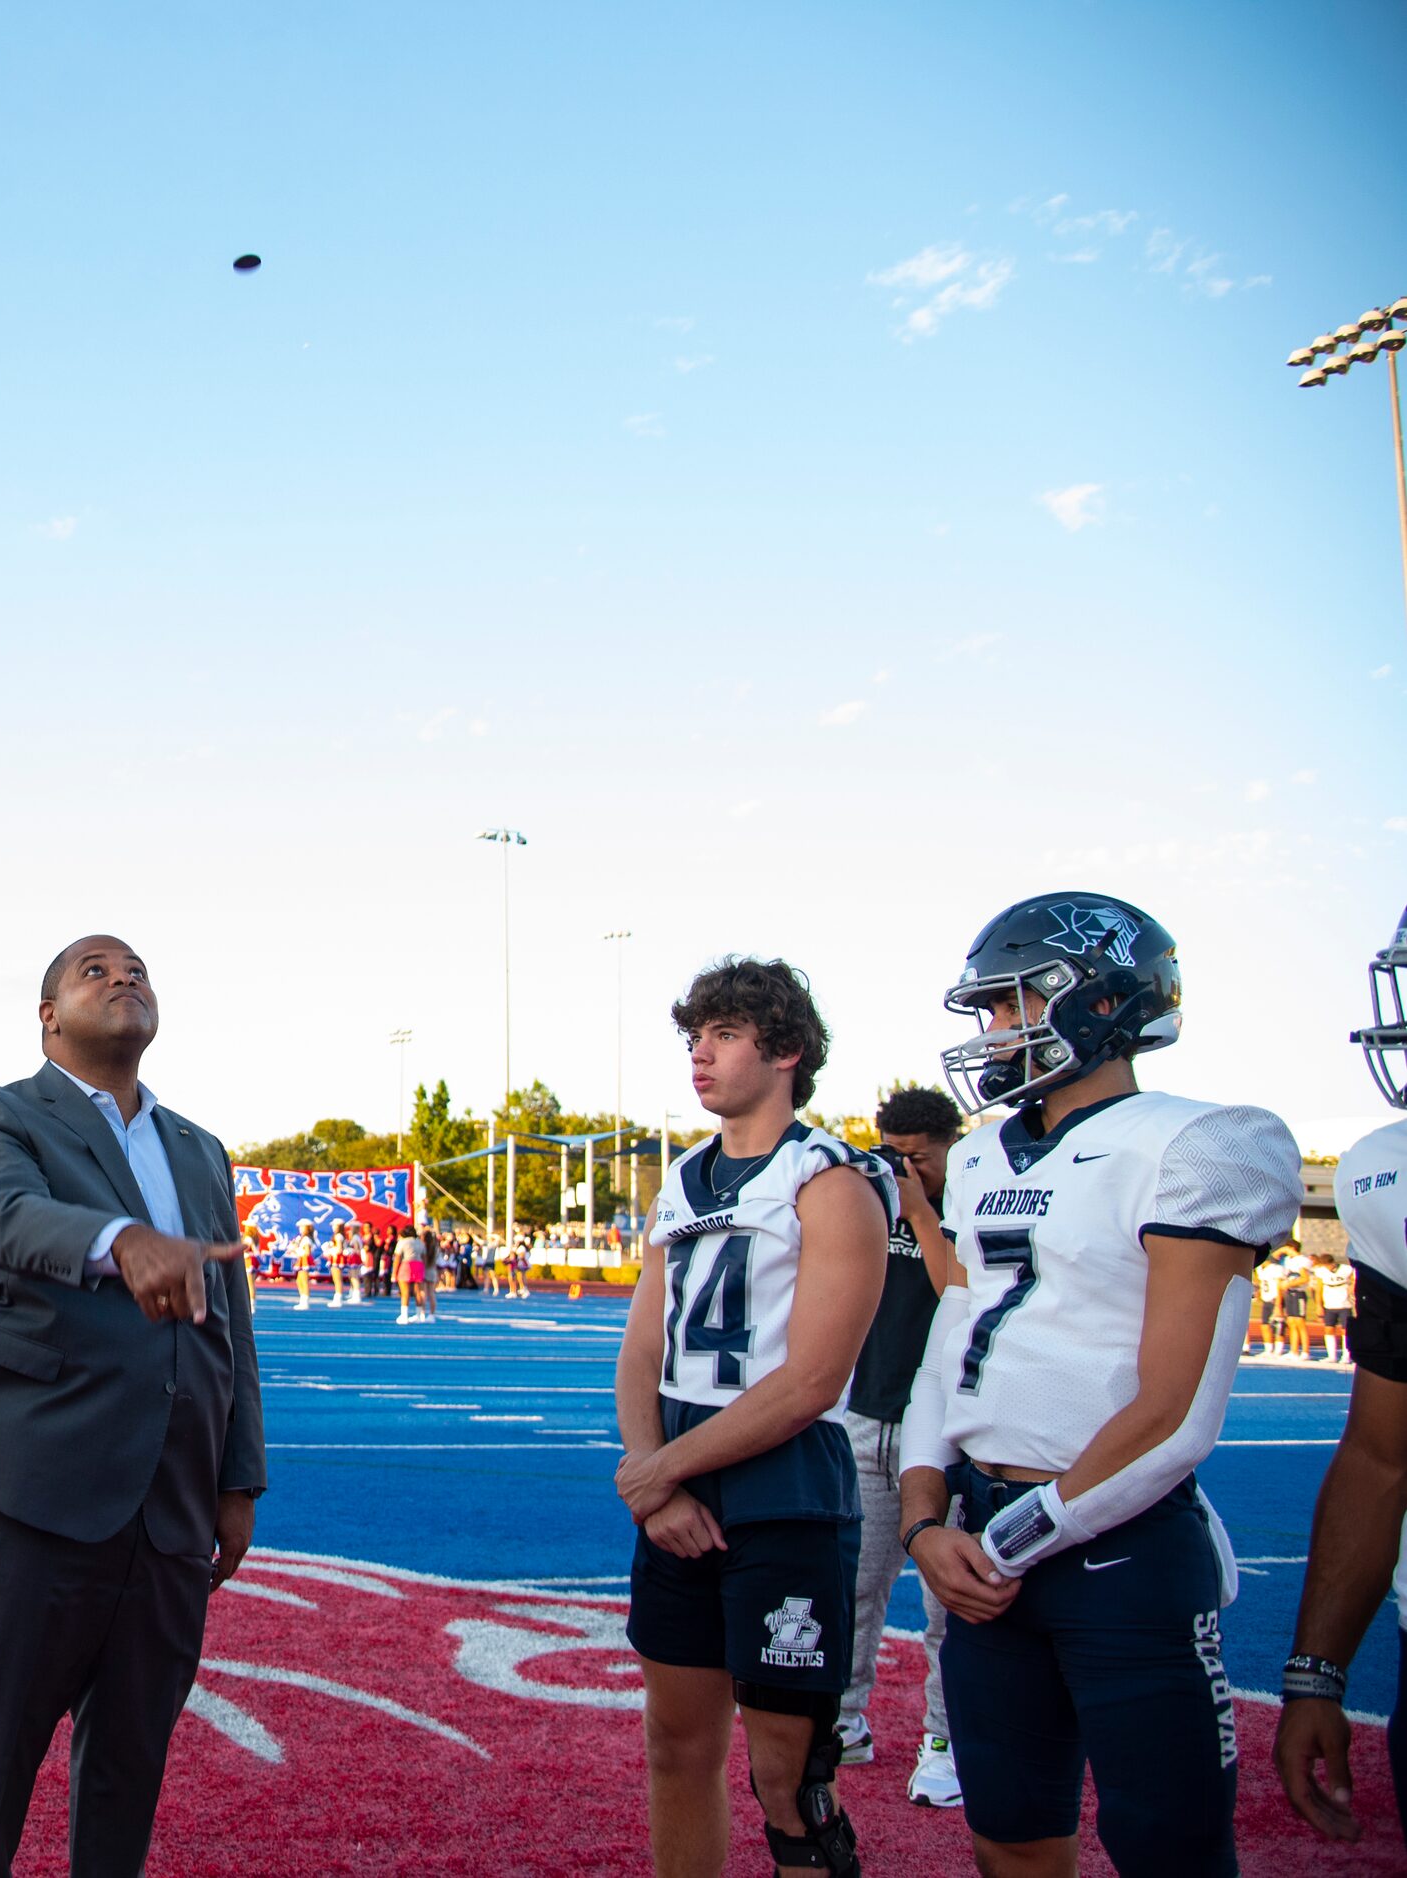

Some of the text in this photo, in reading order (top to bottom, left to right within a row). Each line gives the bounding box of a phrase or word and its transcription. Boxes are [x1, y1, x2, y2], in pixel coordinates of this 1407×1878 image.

[1354, 1170, 1398, 1196] FOR HIM
[974, 1188, 1054, 1217] WARRIORS
[664, 1228, 759, 1391] 14
[956, 1223, 1042, 1397] 7
[760, 1647, 824, 1668] ATHLETICS
